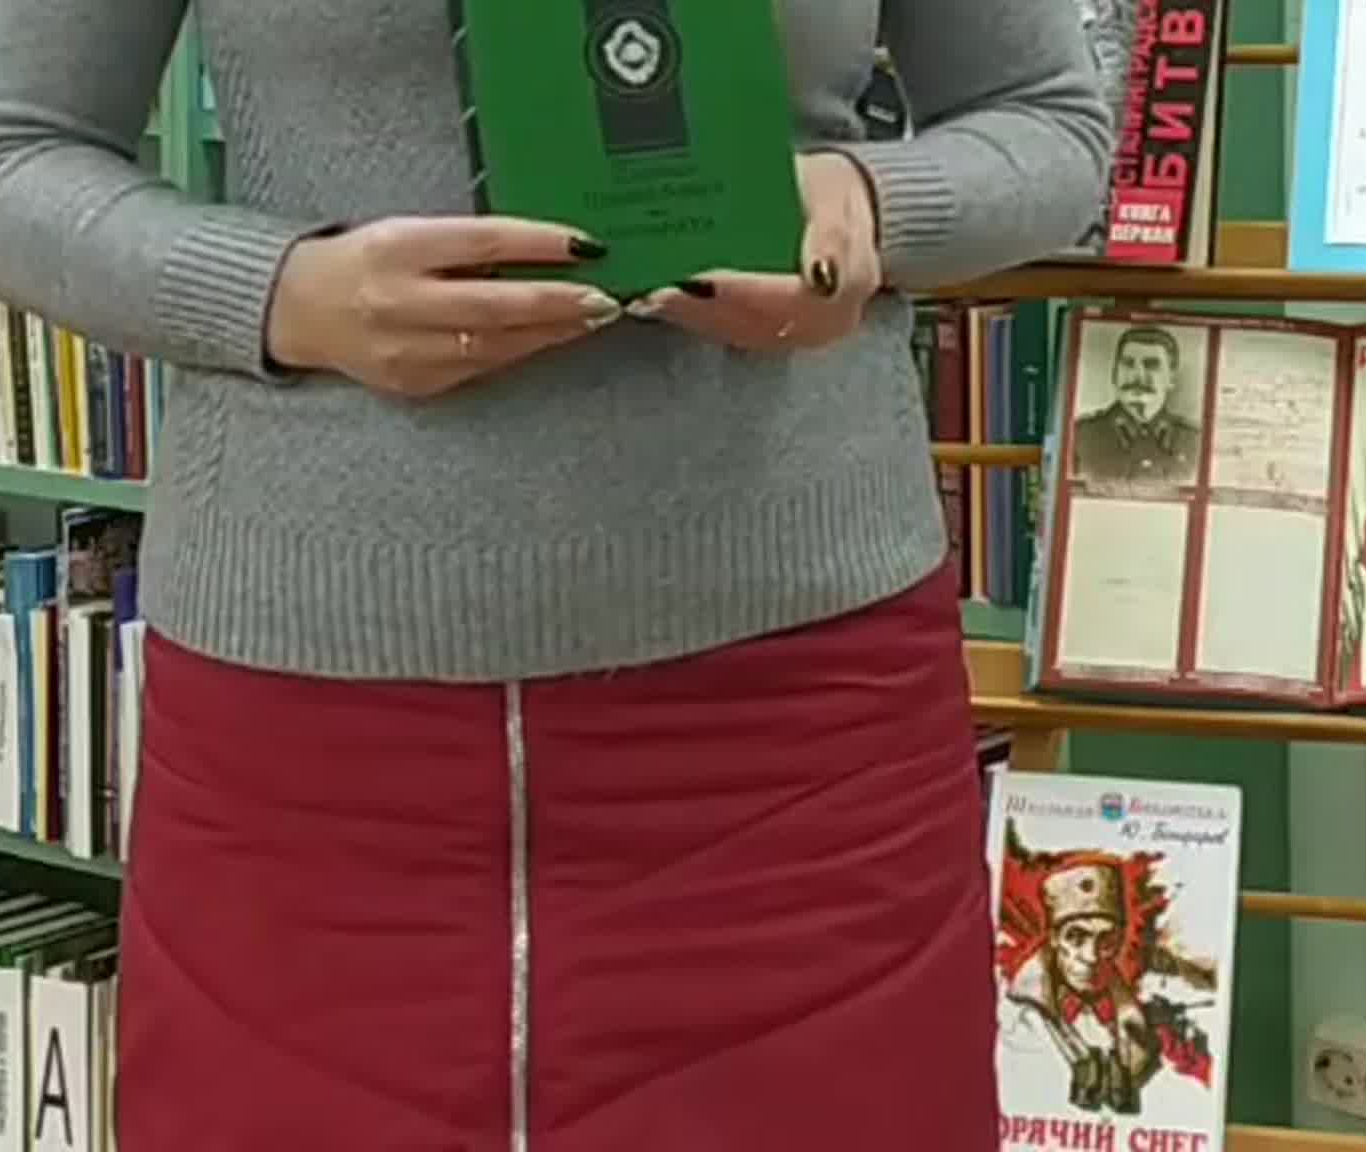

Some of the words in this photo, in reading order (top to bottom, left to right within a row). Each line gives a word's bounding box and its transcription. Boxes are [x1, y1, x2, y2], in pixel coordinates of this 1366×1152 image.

[1118, 202, 1173, 223] КНИГА
[34, 1026, 74, 1147] А
[999, 1112, 1116, 1152] ОРЯЧИЙ
[1127, 1126, 1210, 1152] СНЕГ
